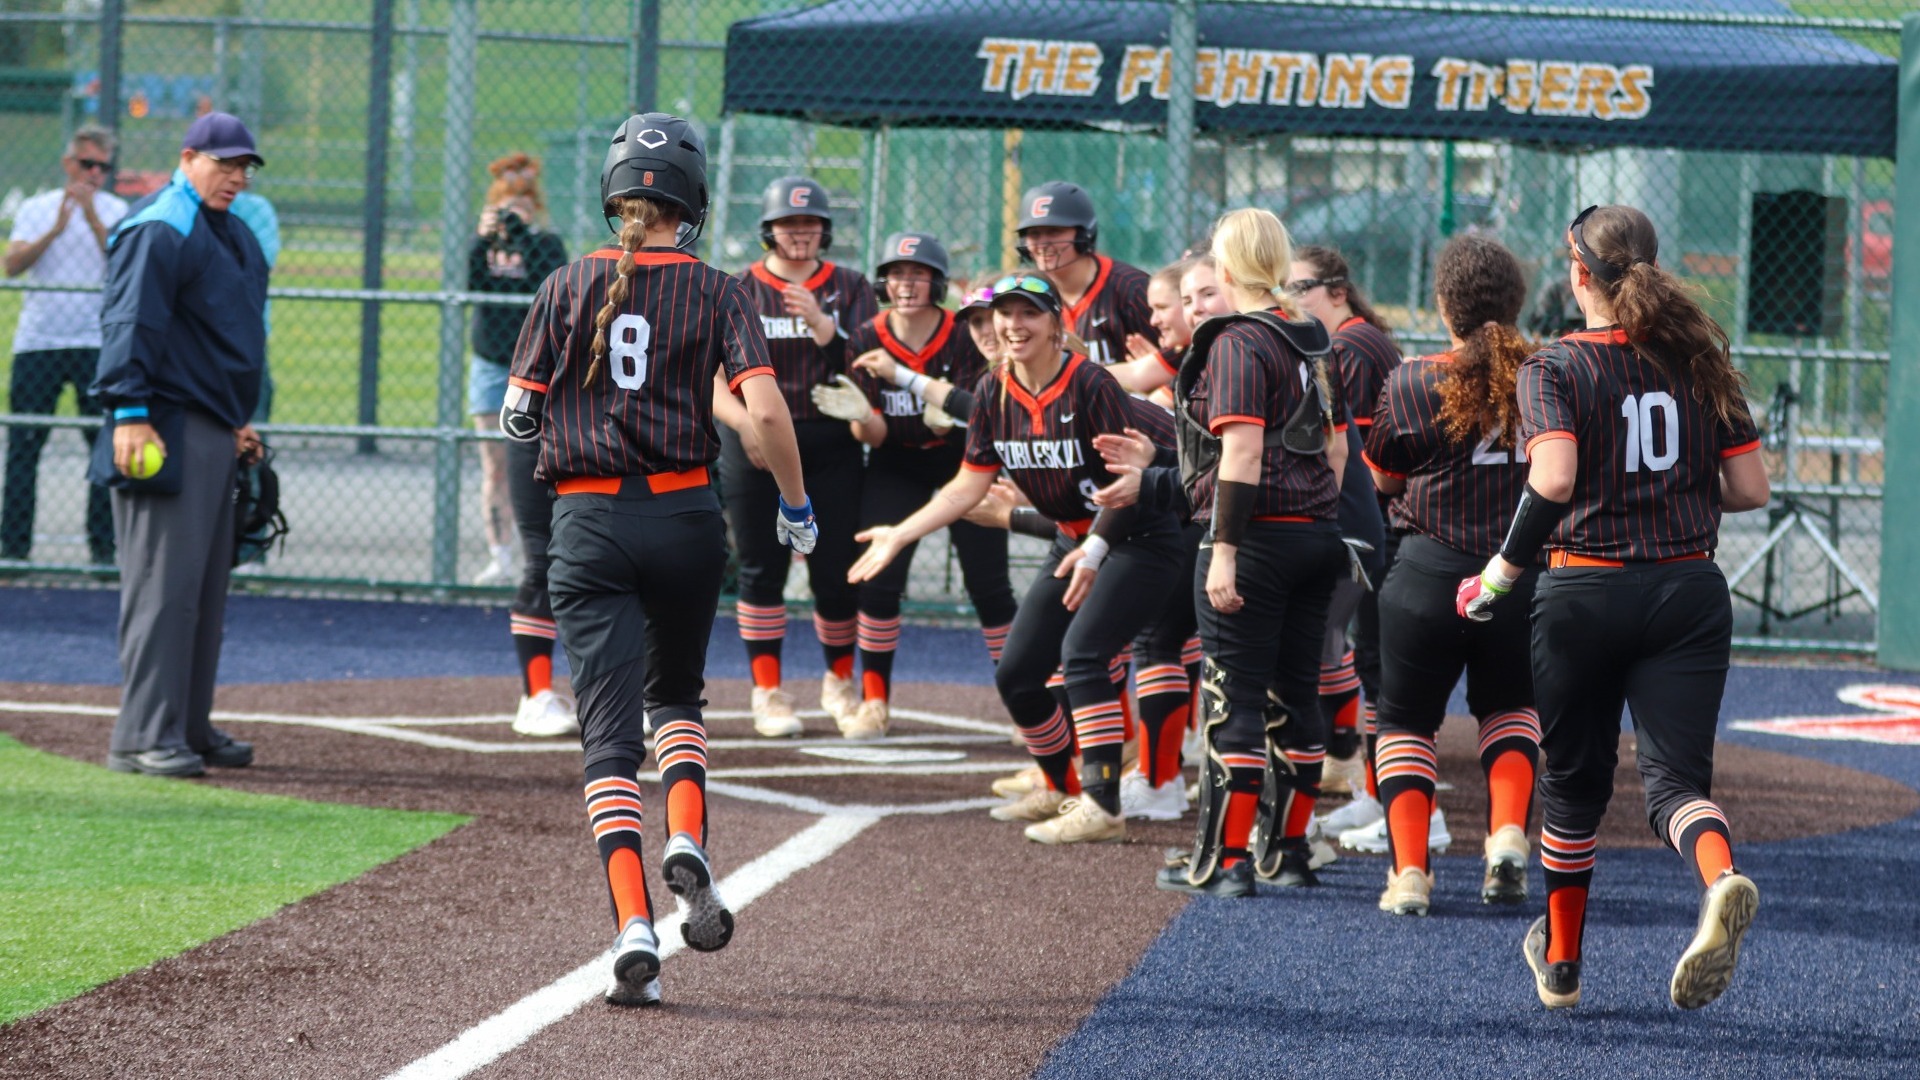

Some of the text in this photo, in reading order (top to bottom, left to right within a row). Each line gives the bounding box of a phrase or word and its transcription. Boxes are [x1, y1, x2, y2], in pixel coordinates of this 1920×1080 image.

[978, 37, 1103, 100] THE
[643, 171, 653, 185] 8
[790, 187, 810, 207] C
[1031, 197, 1052, 218] C
[899, 237, 920, 256] C
[610, 313, 650, 391] 8
[1621, 391, 1680, 473] 10
